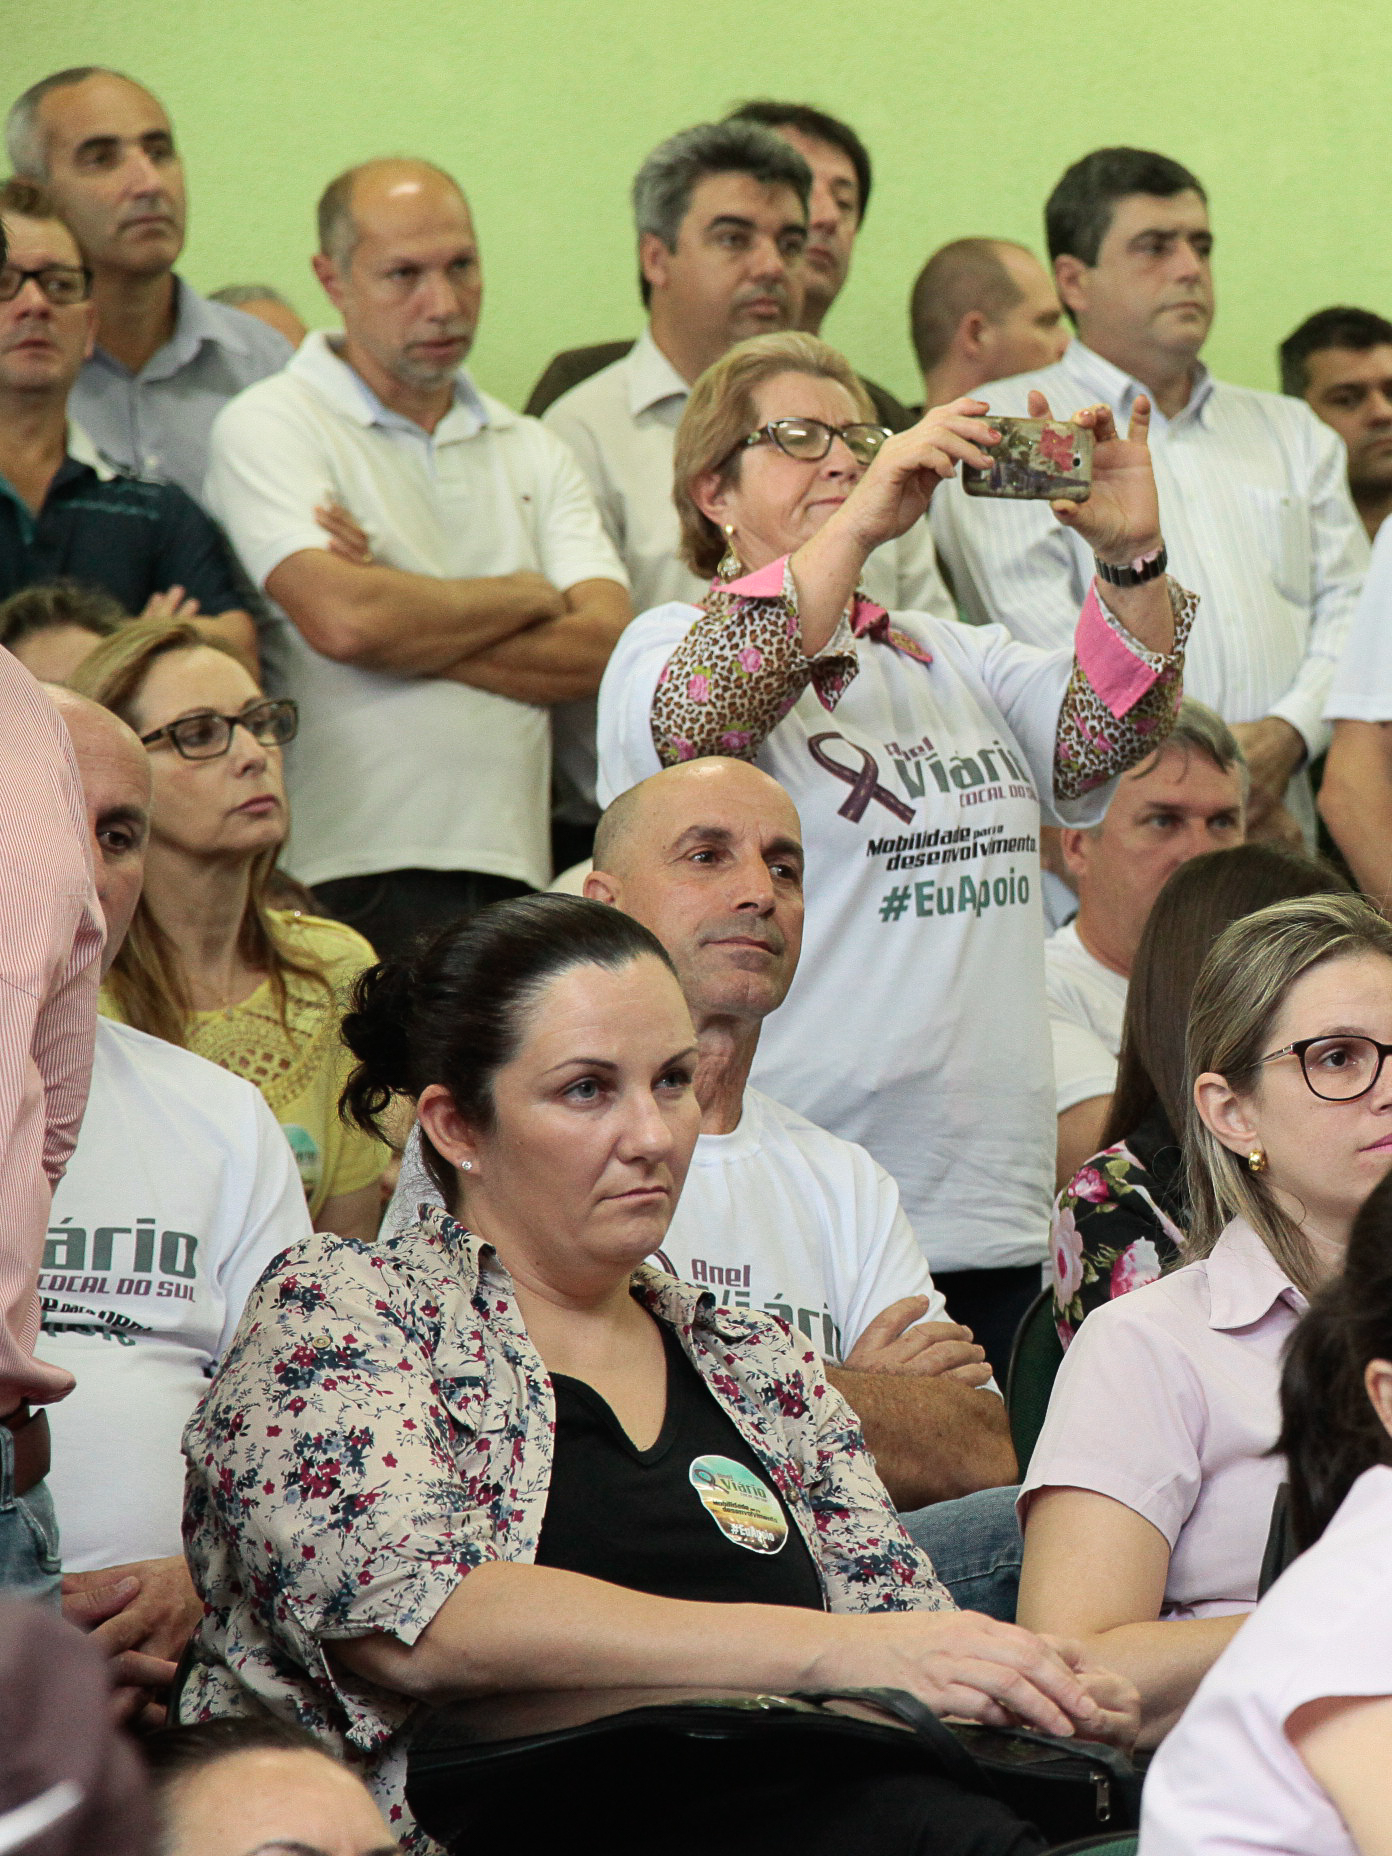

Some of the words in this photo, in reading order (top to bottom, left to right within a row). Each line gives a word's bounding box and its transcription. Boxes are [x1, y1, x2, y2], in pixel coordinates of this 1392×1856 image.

[866, 824, 972, 858] Mobilidade
[878, 867, 1030, 923] #EuApoio
[36, 1273, 111, 1295] COCAL
[115, 1277, 152, 1296] DO
[155, 1280, 196, 1303] SUL
[691, 1258, 751, 1288] Anel
